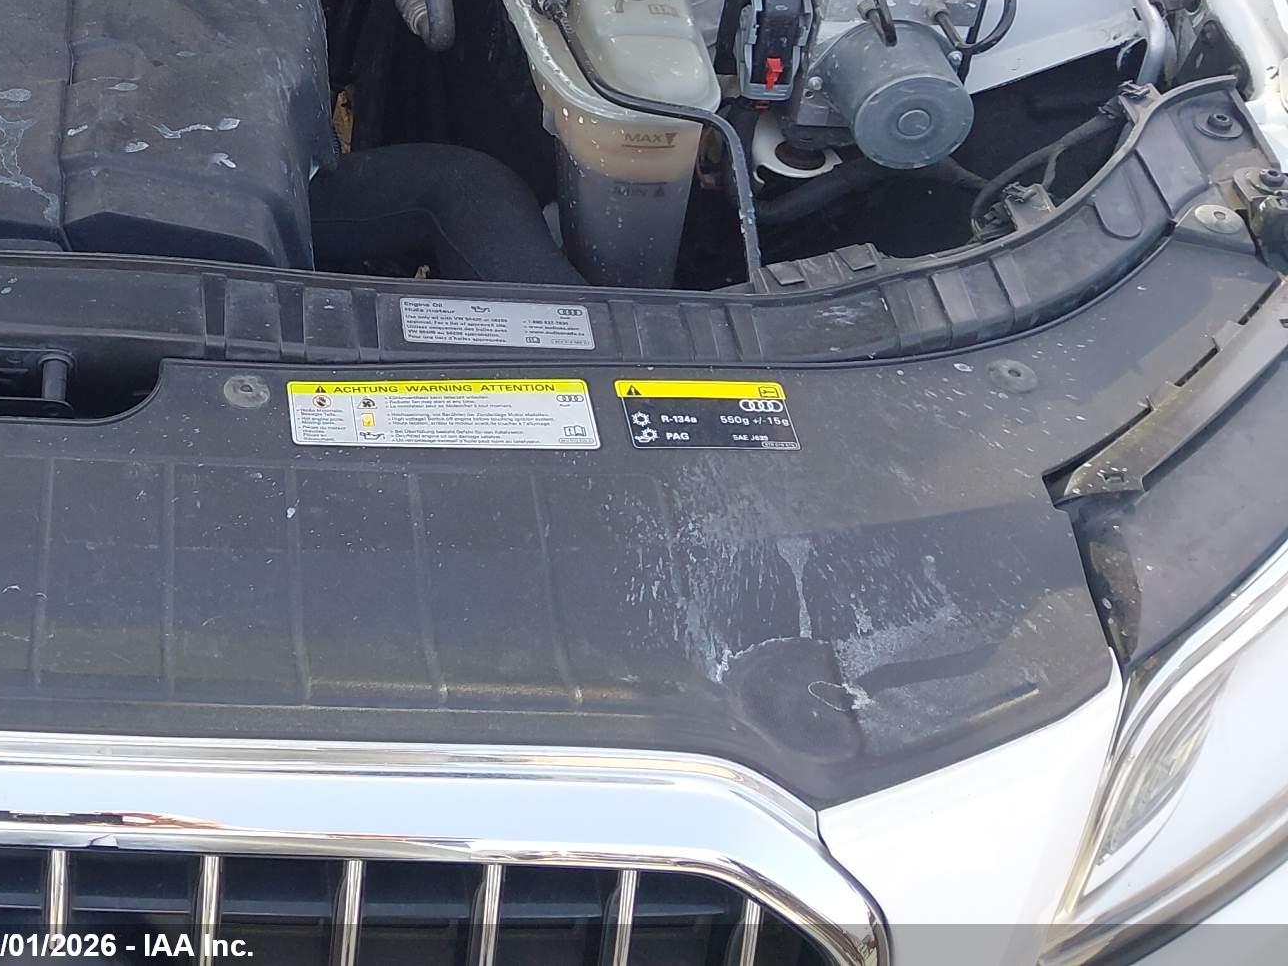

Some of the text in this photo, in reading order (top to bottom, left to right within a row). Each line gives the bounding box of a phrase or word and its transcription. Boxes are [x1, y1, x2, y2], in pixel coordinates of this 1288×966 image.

[624, 132, 662, 143] MAX
[406, 384, 472, 392] WARNING
[480, 384, 555, 392] ATTENTION
[661, 415, 697, 423] R-134a
[720, 416, 750, 426] 550g
[666, 432, 690, 440] PAG
